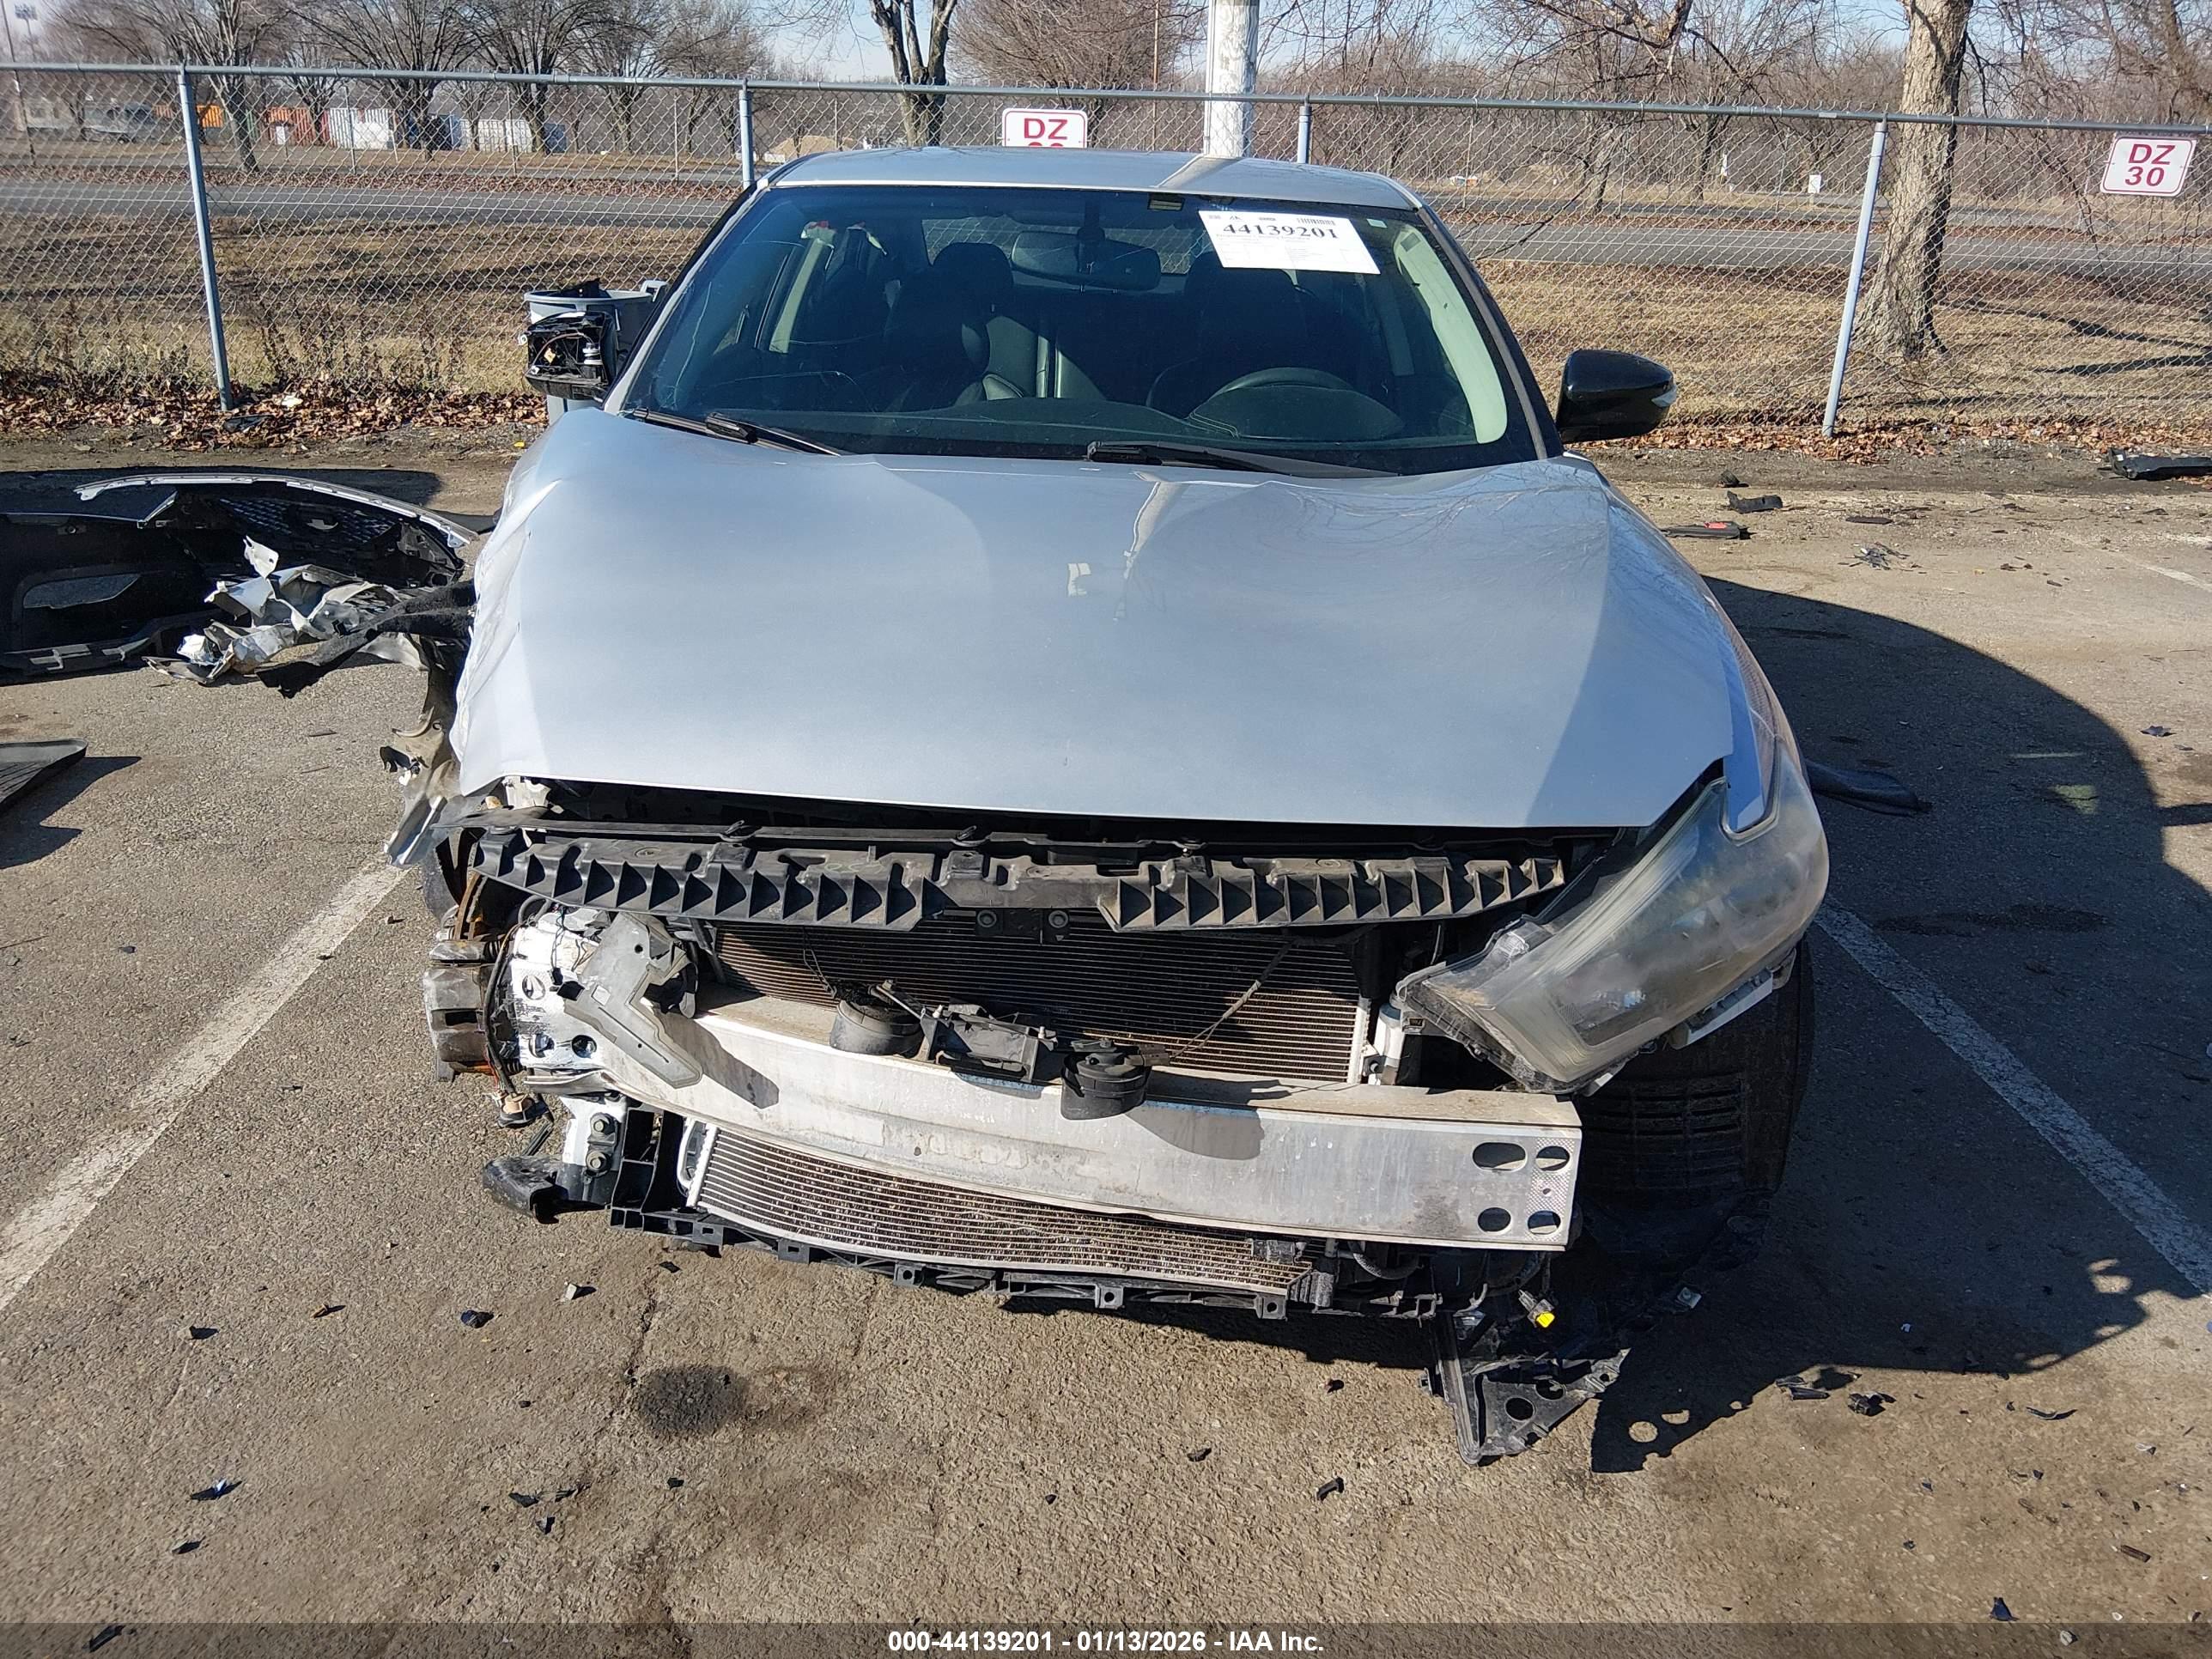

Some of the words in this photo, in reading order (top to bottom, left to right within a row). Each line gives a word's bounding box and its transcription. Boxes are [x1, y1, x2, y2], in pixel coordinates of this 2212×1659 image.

[1024, 118, 1068, 140] DZ
[2128, 143, 2176, 165] DZ
[2124, 166, 2165, 186] 30
[1223, 223, 1339, 239] 44139201
